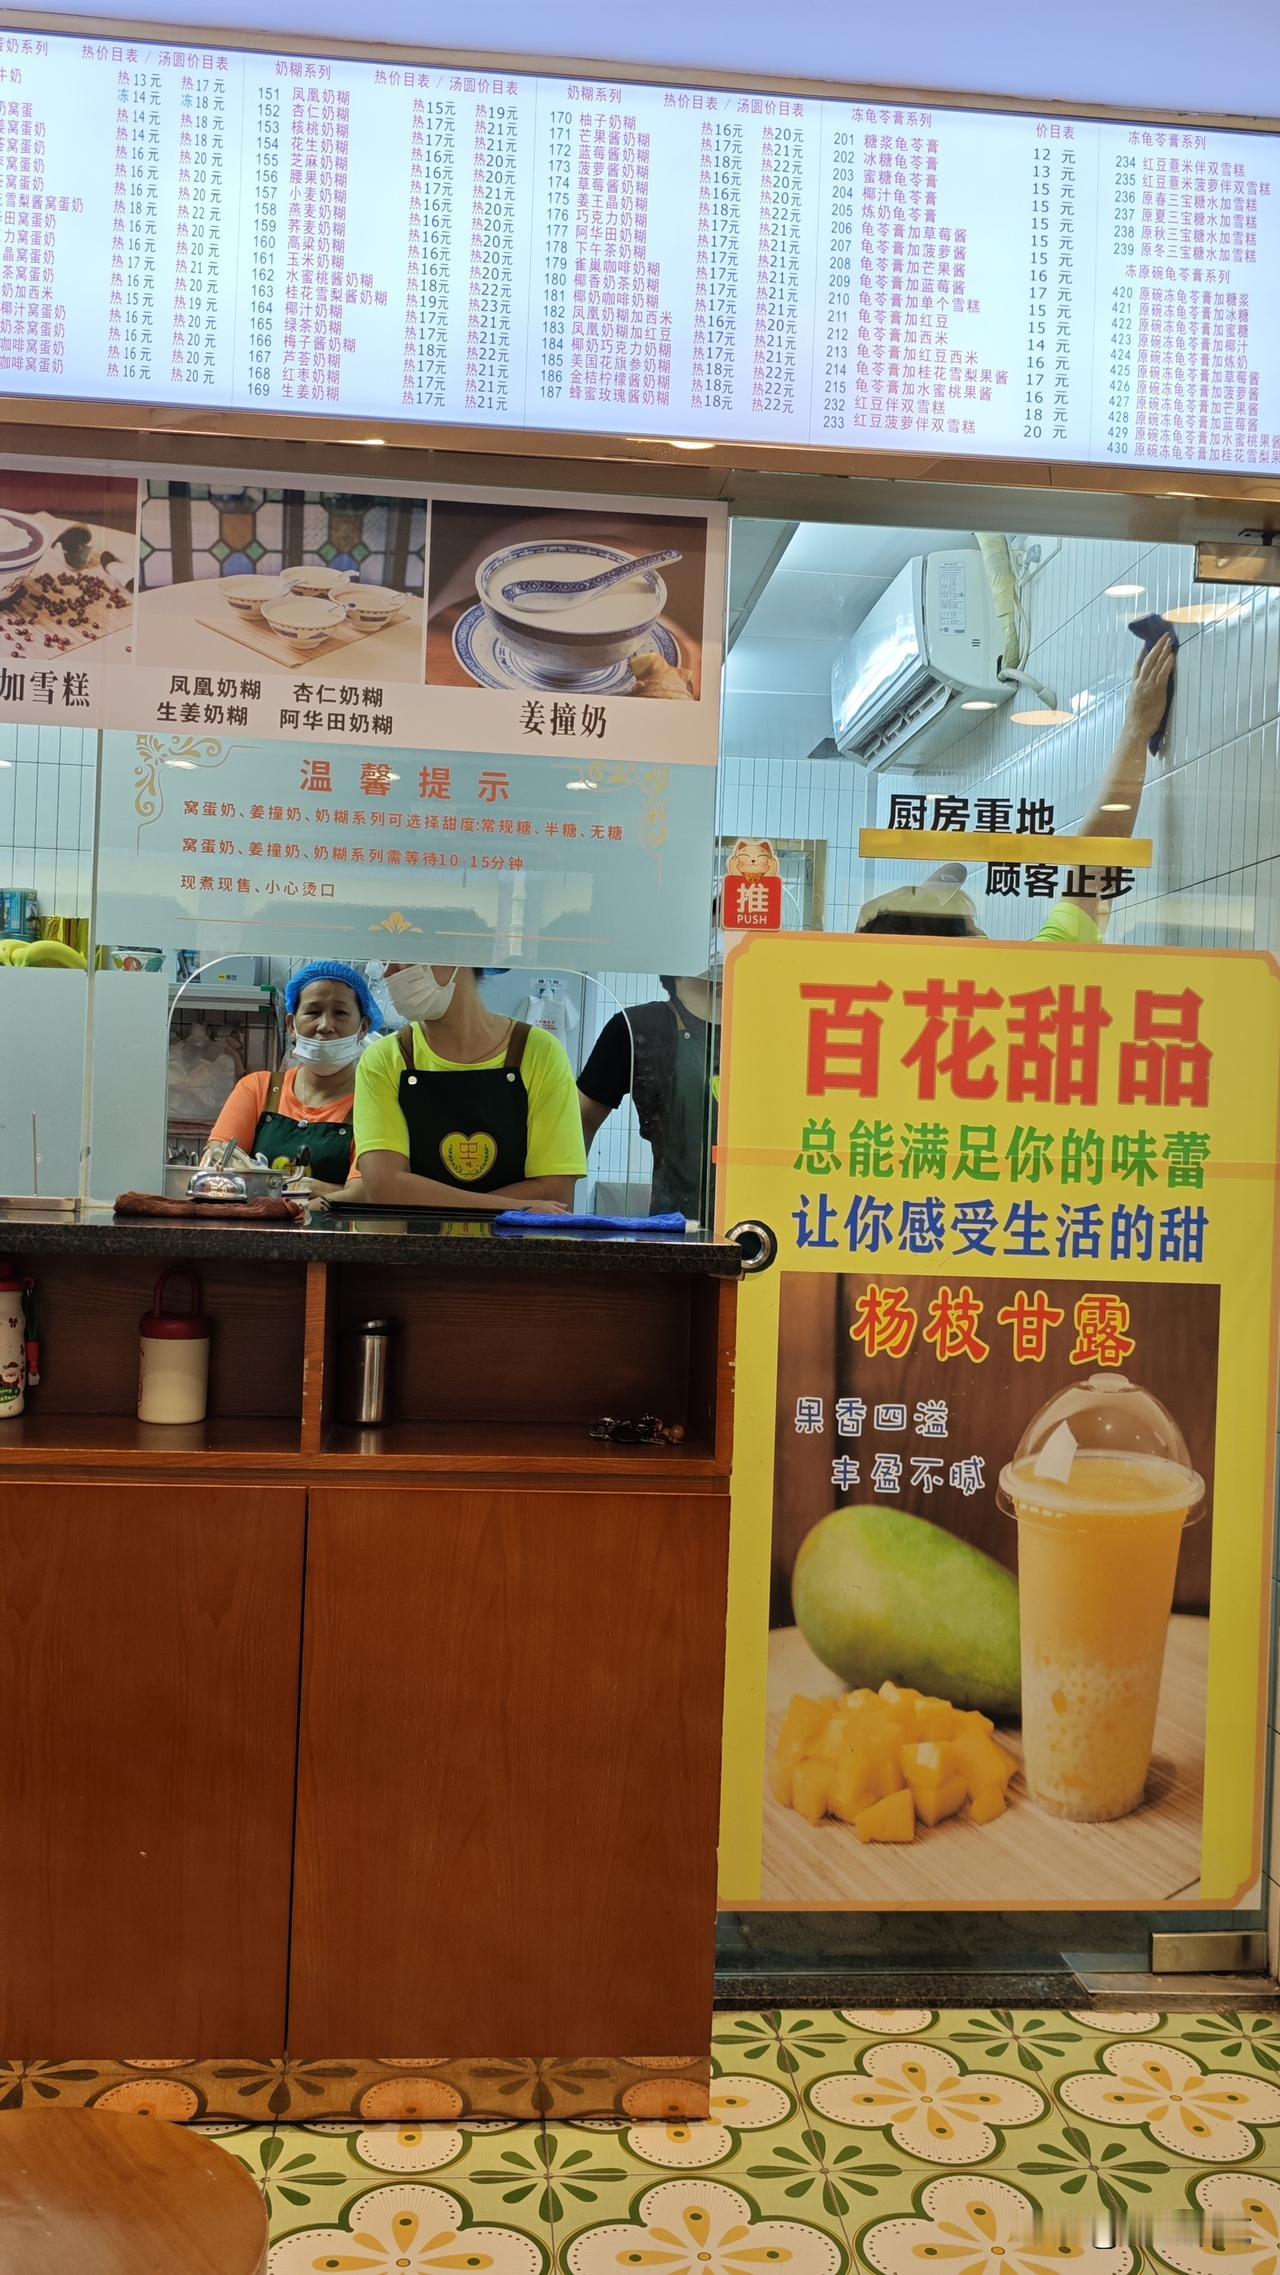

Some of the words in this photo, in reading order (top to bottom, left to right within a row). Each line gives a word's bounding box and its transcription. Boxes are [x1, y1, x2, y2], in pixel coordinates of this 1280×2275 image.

[82, 44, 138, 64] 热价目表
[158, 51, 228, 71] 汤圆价目表
[276, 60, 331, 80] 奶糊系列
[375, 70, 430, 89] 热价目表
[450, 76, 518, 96] 汤圆价目表
[258, 88, 279, 100] 151
[292, 87, 350, 105] 凤凰奶糊
[568, 84, 622, 104] 奶糊系列
[664, 92, 718, 111] 热价目表
[736, 98, 804, 118] 汤圆价目表
[257, 104, 279, 117] 152
[292, 104, 349, 121] 杏仁奶糊
[550, 111, 572, 124] 170
[257, 121, 278, 133] 153
[291, 120, 349, 138] 核桃奶糊
[852, 108, 932, 128] 冻龟苓膏系列
[1036, 124, 1074, 140] 价目表
[550, 128, 571, 140] 171
[834, 133, 854, 146] 201
[864, 134, 938, 153] 糖浆龟苓膏
[1128, 130, 1206, 150] 冻龟苓膏系列
[256, 137, 278, 150] 154
[291, 137, 348, 154] 花生奶糊
[290, 153, 347, 170] 芝麻奶糊
[833, 150, 854, 163] 202
[864, 151, 938, 171] 冰糖龟苓膏
[1116, 156, 1136, 167] 234
[289, 170, 347, 187] 腰果奶糊
[548, 176, 569, 189] 174
[863, 169, 938, 188] 蜜糖龟苓膏
[289, 186, 346, 203] 小麦奶糊
[862, 187, 937, 206] 椰汁龟苓膏
[1115, 191, 1135, 202] 236
[288, 203, 346, 220] 燕麦奶糊
[831, 203, 852, 216] 205
[862, 204, 936, 223] 炼奶龟苓膏
[254, 219, 275, 232] 159
[288, 219, 345, 236] 荞麦奶糊
[831, 221, 851, 234] 206
[861, 222, 967, 244] 龟苓膏加草莓酱
[253, 236, 274, 248] 160
[287, 236, 344, 253] 高粱奶糊
[546, 241, 567, 253] 178
[860, 240, 966, 261] 龟苓膏加菠萝酱
[1114, 243, 1134, 255] 239
[286, 252, 344, 269] 玉米奶糊
[860, 256, 966, 278] 龟苓膏加芒果酱
[286, 269, 374, 288] 水蜜桃酱奶糊
[859, 273, 965, 295] 龟苓膏加蓝莓酱
[251, 285, 273, 298] 163
[285, 285, 388, 305] 桂花雪梨酱奶糊
[544, 289, 565, 302] 181
[828, 292, 849, 305] 210
[858, 291, 980, 313] 龟苓膏加单个雪糕
[1113, 287, 1132, 298] 420
[285, 301, 342, 319] 椰汁奶糊
[1112, 302, 1132, 313] 421
[284, 318, 341, 335] 绿茶奶糊
[858, 308, 949, 329] 龟苓膏加红豆
[250, 334, 271, 347] 166
[284, 334, 356, 353] 梅子酱奶糊
[542, 338, 563, 350] 184
[857, 326, 948, 345] 龟苓膏加西米
[283, 351, 340, 368] 芦荟奶糊
[826, 345, 847, 358] 213
[856, 344, 978, 365] 龟苓膏加红豆西米
[1110, 349, 1130, 360] 424
[249, 367, 270, 380] 168
[282, 367, 339, 384] 红枣奶糊
[541, 370, 562, 382] 186
[856, 361, 1008, 385] 龟苓膏加桂花雪梨果酱
[248, 383, 269, 396] 169
[282, 384, 339, 401] 生姜奶糊
[540, 386, 561, 398] 187
[855, 378, 992, 401] 龟苓膏加水蜜桃果酱
[824, 398, 845, 411] 232
[854, 397, 946, 415] 红豆伴双雪糕
[1109, 396, 1129, 407] 427
[823, 416, 844, 428] 233
[854, 414, 976, 434] 红豆菠萝伴双雪糕
[0, 667, 90, 708] 加雪糕
[170, 675, 262, 700] 凤凰奶糊
[293, 684, 383, 708] 杏仁奶糊
[157, 702, 248, 727] 生姜奶糊
[280, 708, 393, 736] 阿华田奶糊
[519, 700, 607, 739] 姜撞奶
[300, 758, 511, 803] 温馨提示
[887, 793, 1055, 836] 厨房重地
[180, 874, 336, 898] 现煮现售、小心烫口
[985, 862, 1136, 899] 顾客止步
[736, 882, 769, 913] 推
[737, 914, 767, 925] PUSH
[800, 978, 1213, 1107] 百花甜品
[793, 1116, 1212, 1190] 总能满足你的味蕾
[792, 1193, 1209, 1263] 让你感受生活的甜
[850, 1283, 1135, 1367] 杨枝甘露
[794, 1397, 948, 1438] 果香四溢
[831, 1453, 986, 1496] 丰盈不腻
